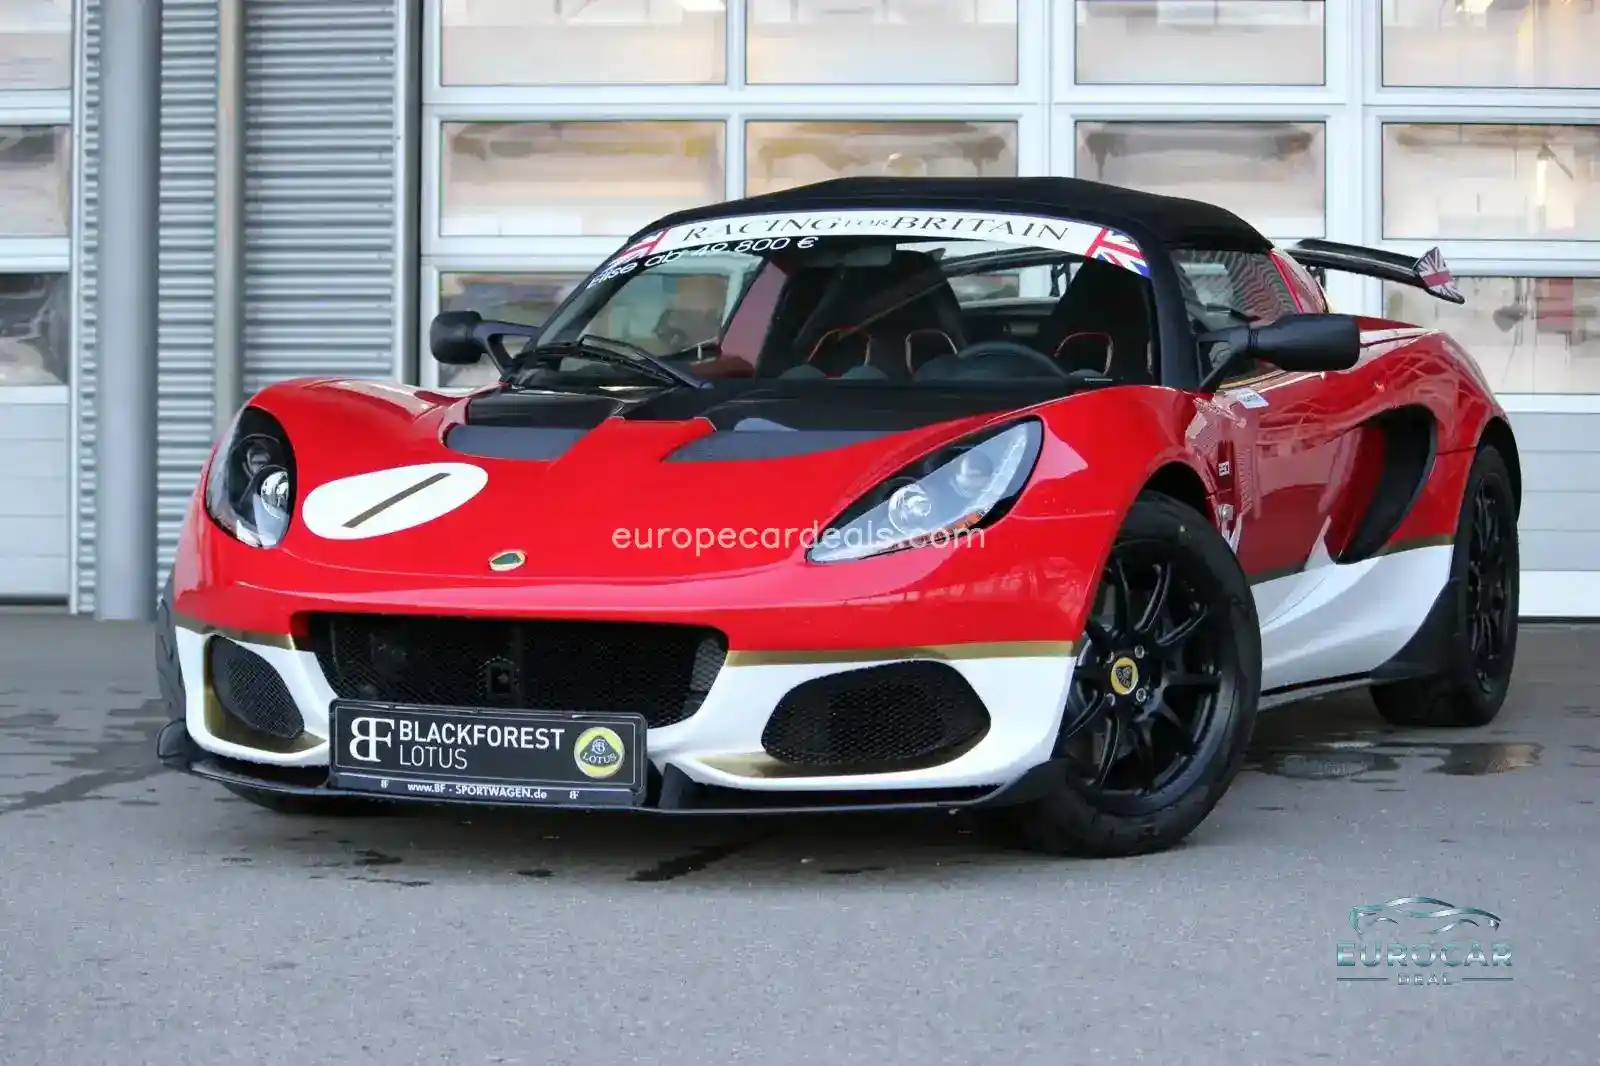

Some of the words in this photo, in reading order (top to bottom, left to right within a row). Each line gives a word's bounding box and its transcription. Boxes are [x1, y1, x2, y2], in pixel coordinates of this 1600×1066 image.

[683, 216, 842, 242] RACING
[890, 215, 1069, 242] BRITAIN
[644, 250, 681, 267] ab
[797, 236, 819, 249] €
[341, 472, 452, 528] 1
[399, 719, 565, 750] BLACKFOREST
[399, 744, 468, 770] LOTUS
[582, 752, 617, 764] LOTUS
